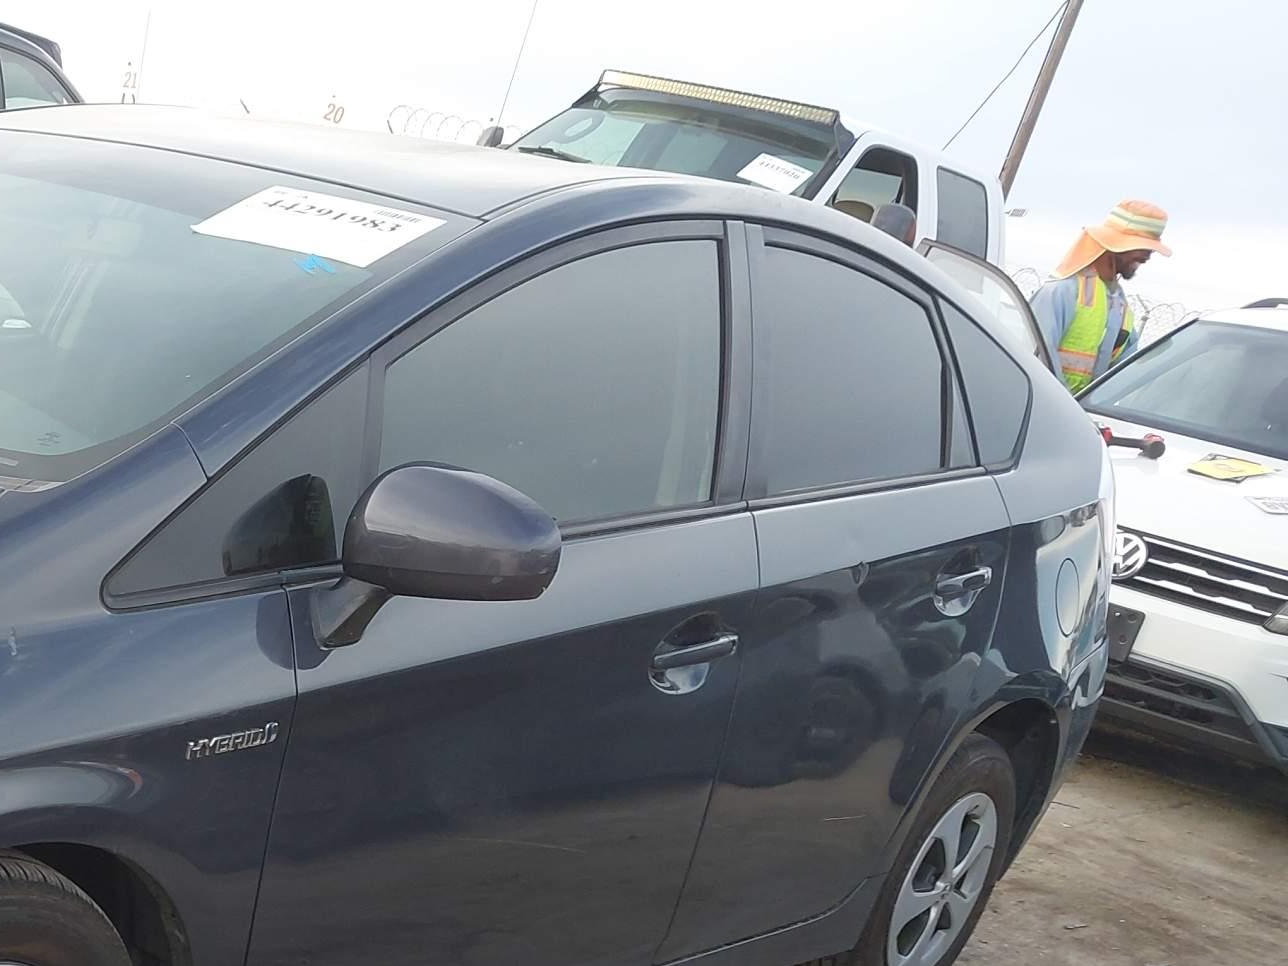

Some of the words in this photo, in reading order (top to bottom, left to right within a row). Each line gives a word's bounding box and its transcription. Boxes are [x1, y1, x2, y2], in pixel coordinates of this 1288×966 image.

[122, 71, 137, 89] 21
[323, 102, 345, 124] 20
[264, 199, 402, 234] 44291983
[185, 728, 264, 761] HYBRID
